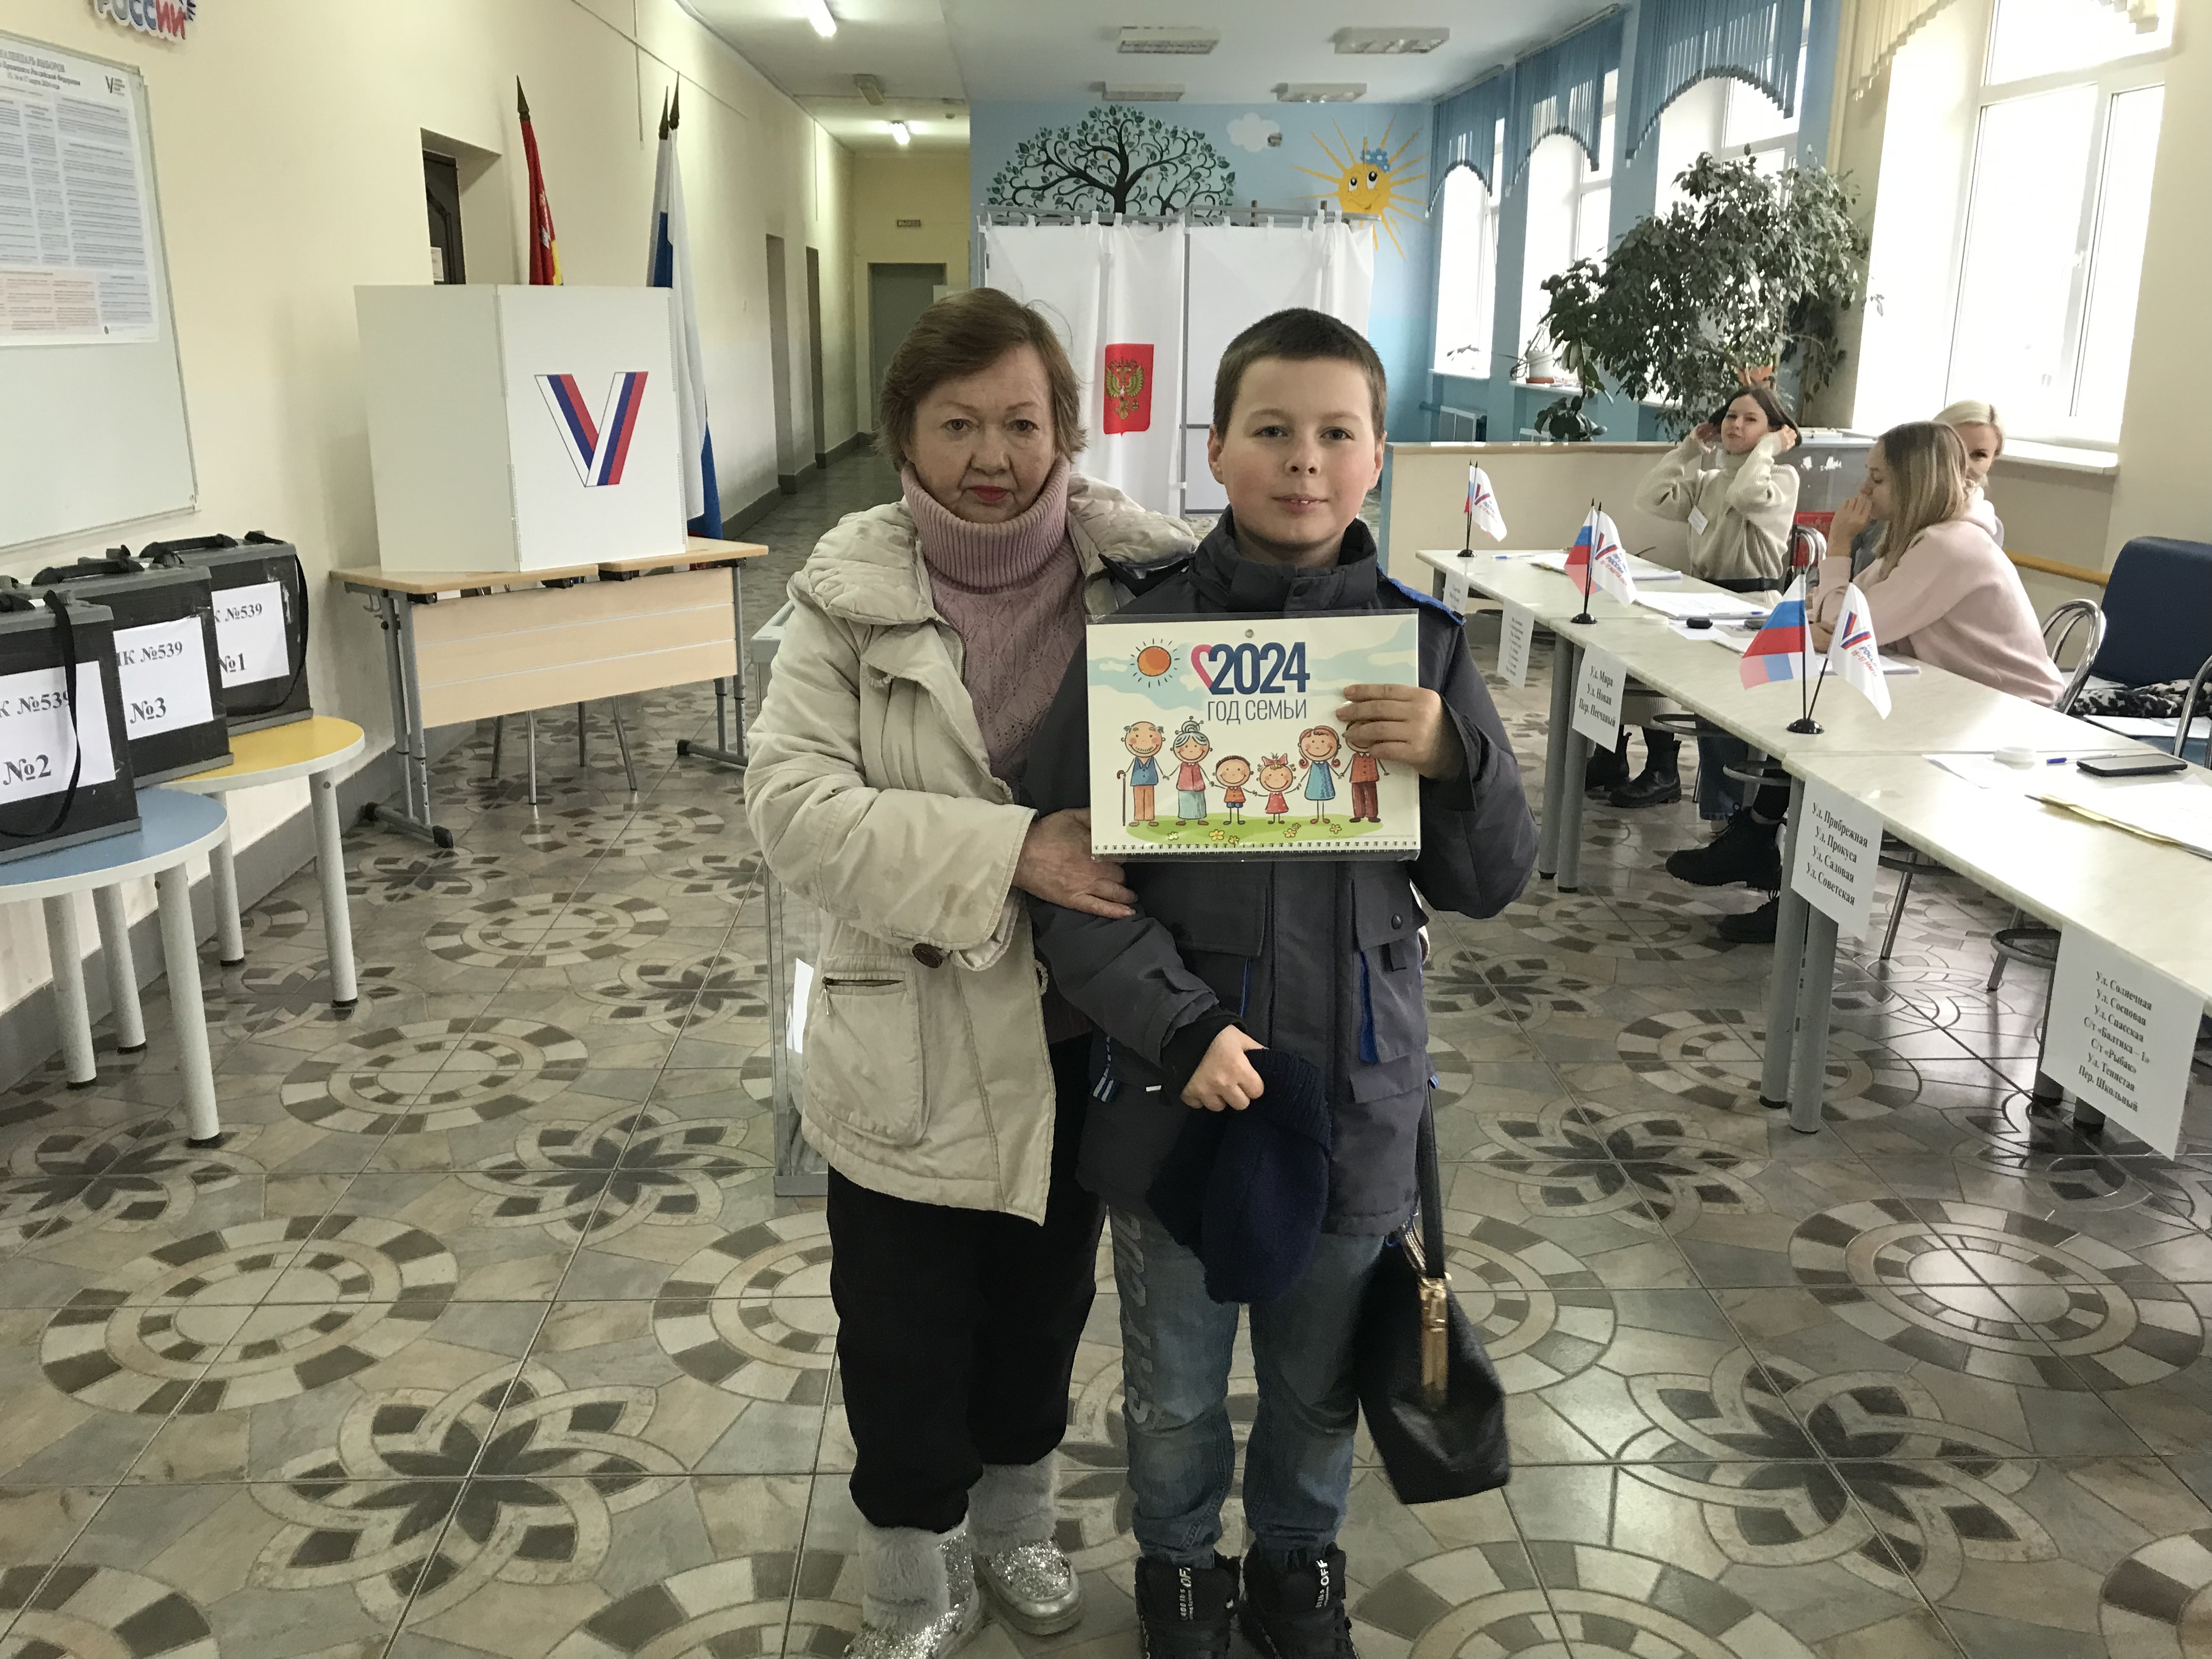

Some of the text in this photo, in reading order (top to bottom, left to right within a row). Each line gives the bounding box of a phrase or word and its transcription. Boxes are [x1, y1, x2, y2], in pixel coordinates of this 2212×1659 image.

[225, 603, 263, 622] №539
[140, 641, 183, 663] №539
[1209, 642, 1311, 695] 2024
[1600, 670, 1613, 689] Мира
[129, 697, 166, 724] №3
[1596, 687, 1612, 706] Новая
[1590, 704, 1616, 727] Песчаный
[3, 754, 52, 786] №2
[1812, 802, 1869, 848] Ул. Прибрежная
[1814, 825, 1858, 864] Ул. Прокуса
[1812, 844, 1854, 884] Ул. Садовая
[1806, 861, 1855, 906] Ул. Советская
[2096, 970, 2152, 1011] Ул. Солнечная
[2096, 989, 2108, 1005] Ул.
[2094, 1005, 2144, 1043] Ул. Спасская
[2097, 1026, 2133, 1054] «Балтика
[2087, 1052, 2100, 1069] Ул.
[2104, 1048, 2137, 1074] «Рыбак»
[2079, 1064, 2138, 1113] Пер. Школьный
[1316, 1559, 1329, 1587] OFF
